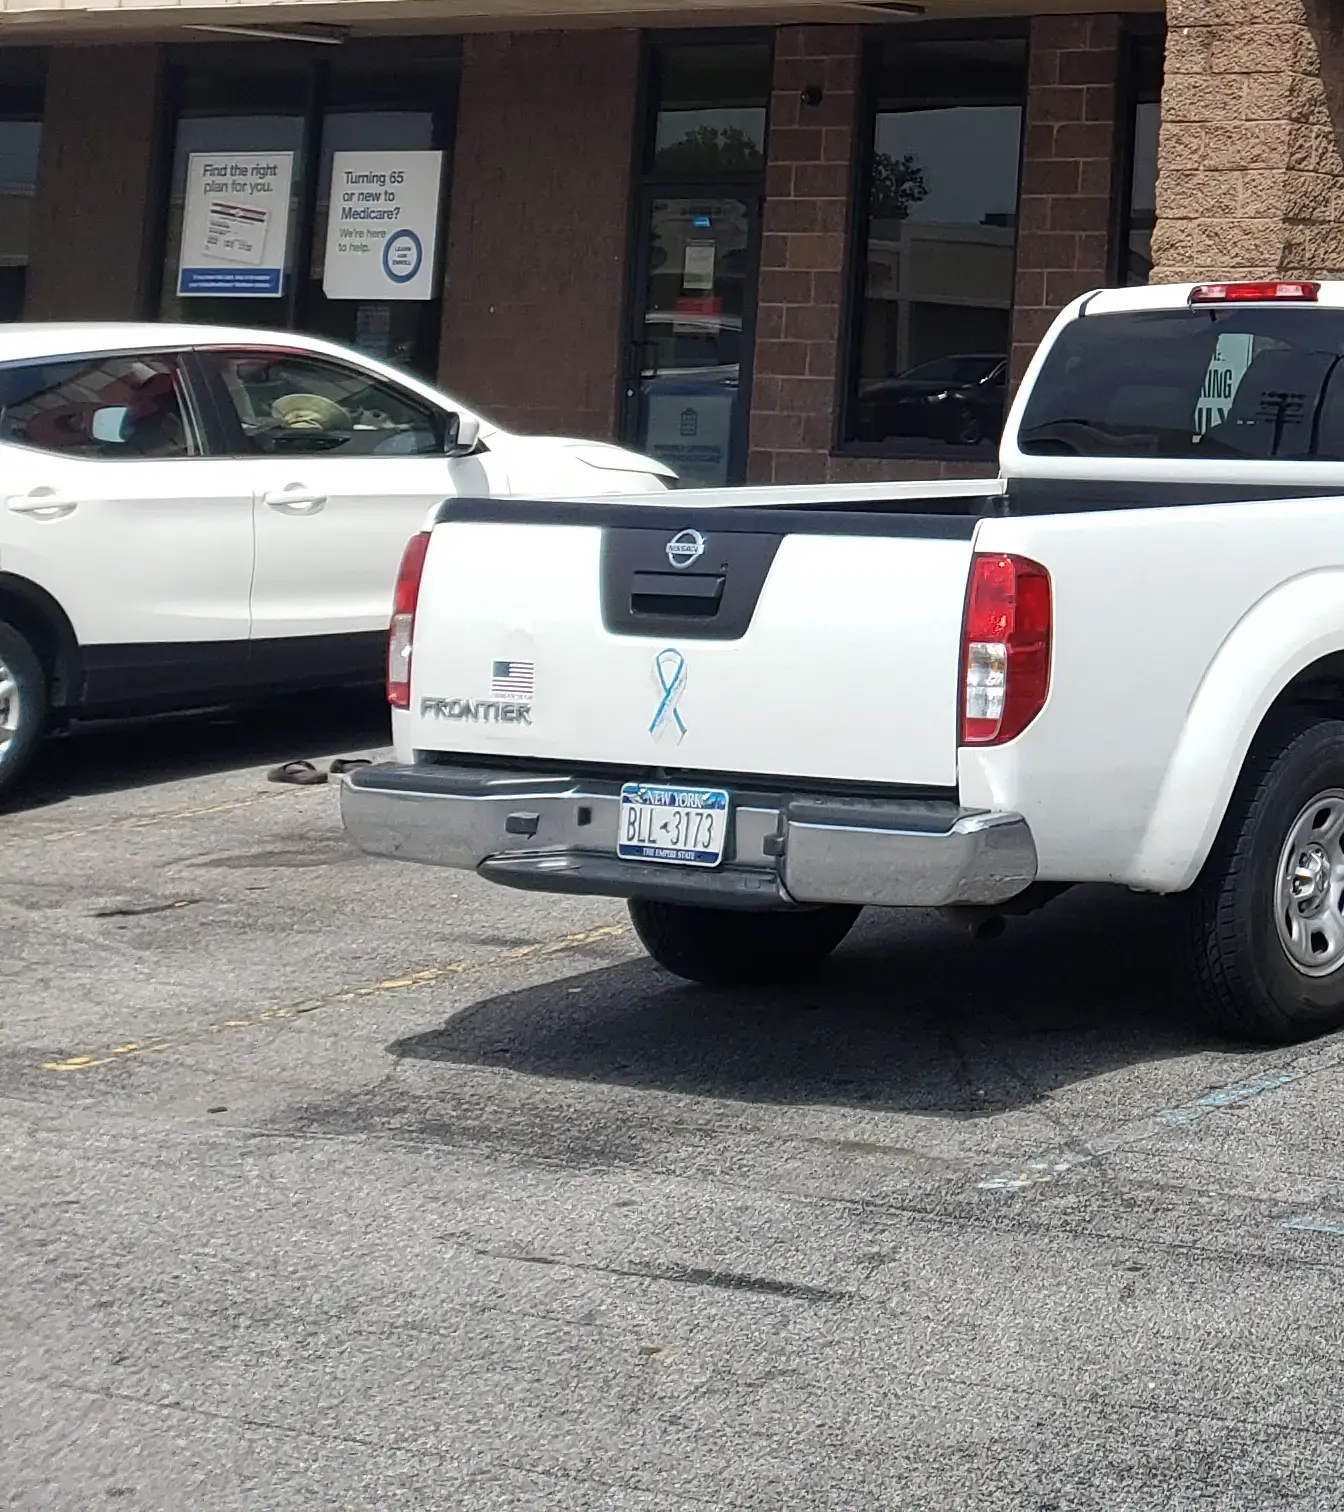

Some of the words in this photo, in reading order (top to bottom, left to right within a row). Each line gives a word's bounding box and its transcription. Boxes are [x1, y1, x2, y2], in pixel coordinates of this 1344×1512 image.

[202, 164, 228, 177] Find
[230, 164, 248, 177] the
[251, 164, 277, 179] right
[344, 171, 386, 187] Turning
[389, 171, 404, 184] 65
[204, 180, 228, 195] plan
[231, 180, 248, 192] for
[249, 183, 273, 195] you.
[343, 192, 355, 202] or
[357, 191, 381, 202] new
[384, 190, 395, 202] to
[341, 207, 400, 220] Medicare?
[339, 228, 364, 238] We're
[367, 228, 387, 238] here
[338, 243, 347, 252] to
[668, 544, 699, 553] NISSAN
[420, 695, 533, 726] FRONTIER
[646, 790, 672, 806] NEW
[674, 791, 702, 808] YORK
[627, 806, 657, 844] BLL
[670, 810, 714, 849] 3173
[642, 847, 654, 856] THE
[655, 848, 676, 858] EMPIRE
[678, 850, 695, 860] STATE
